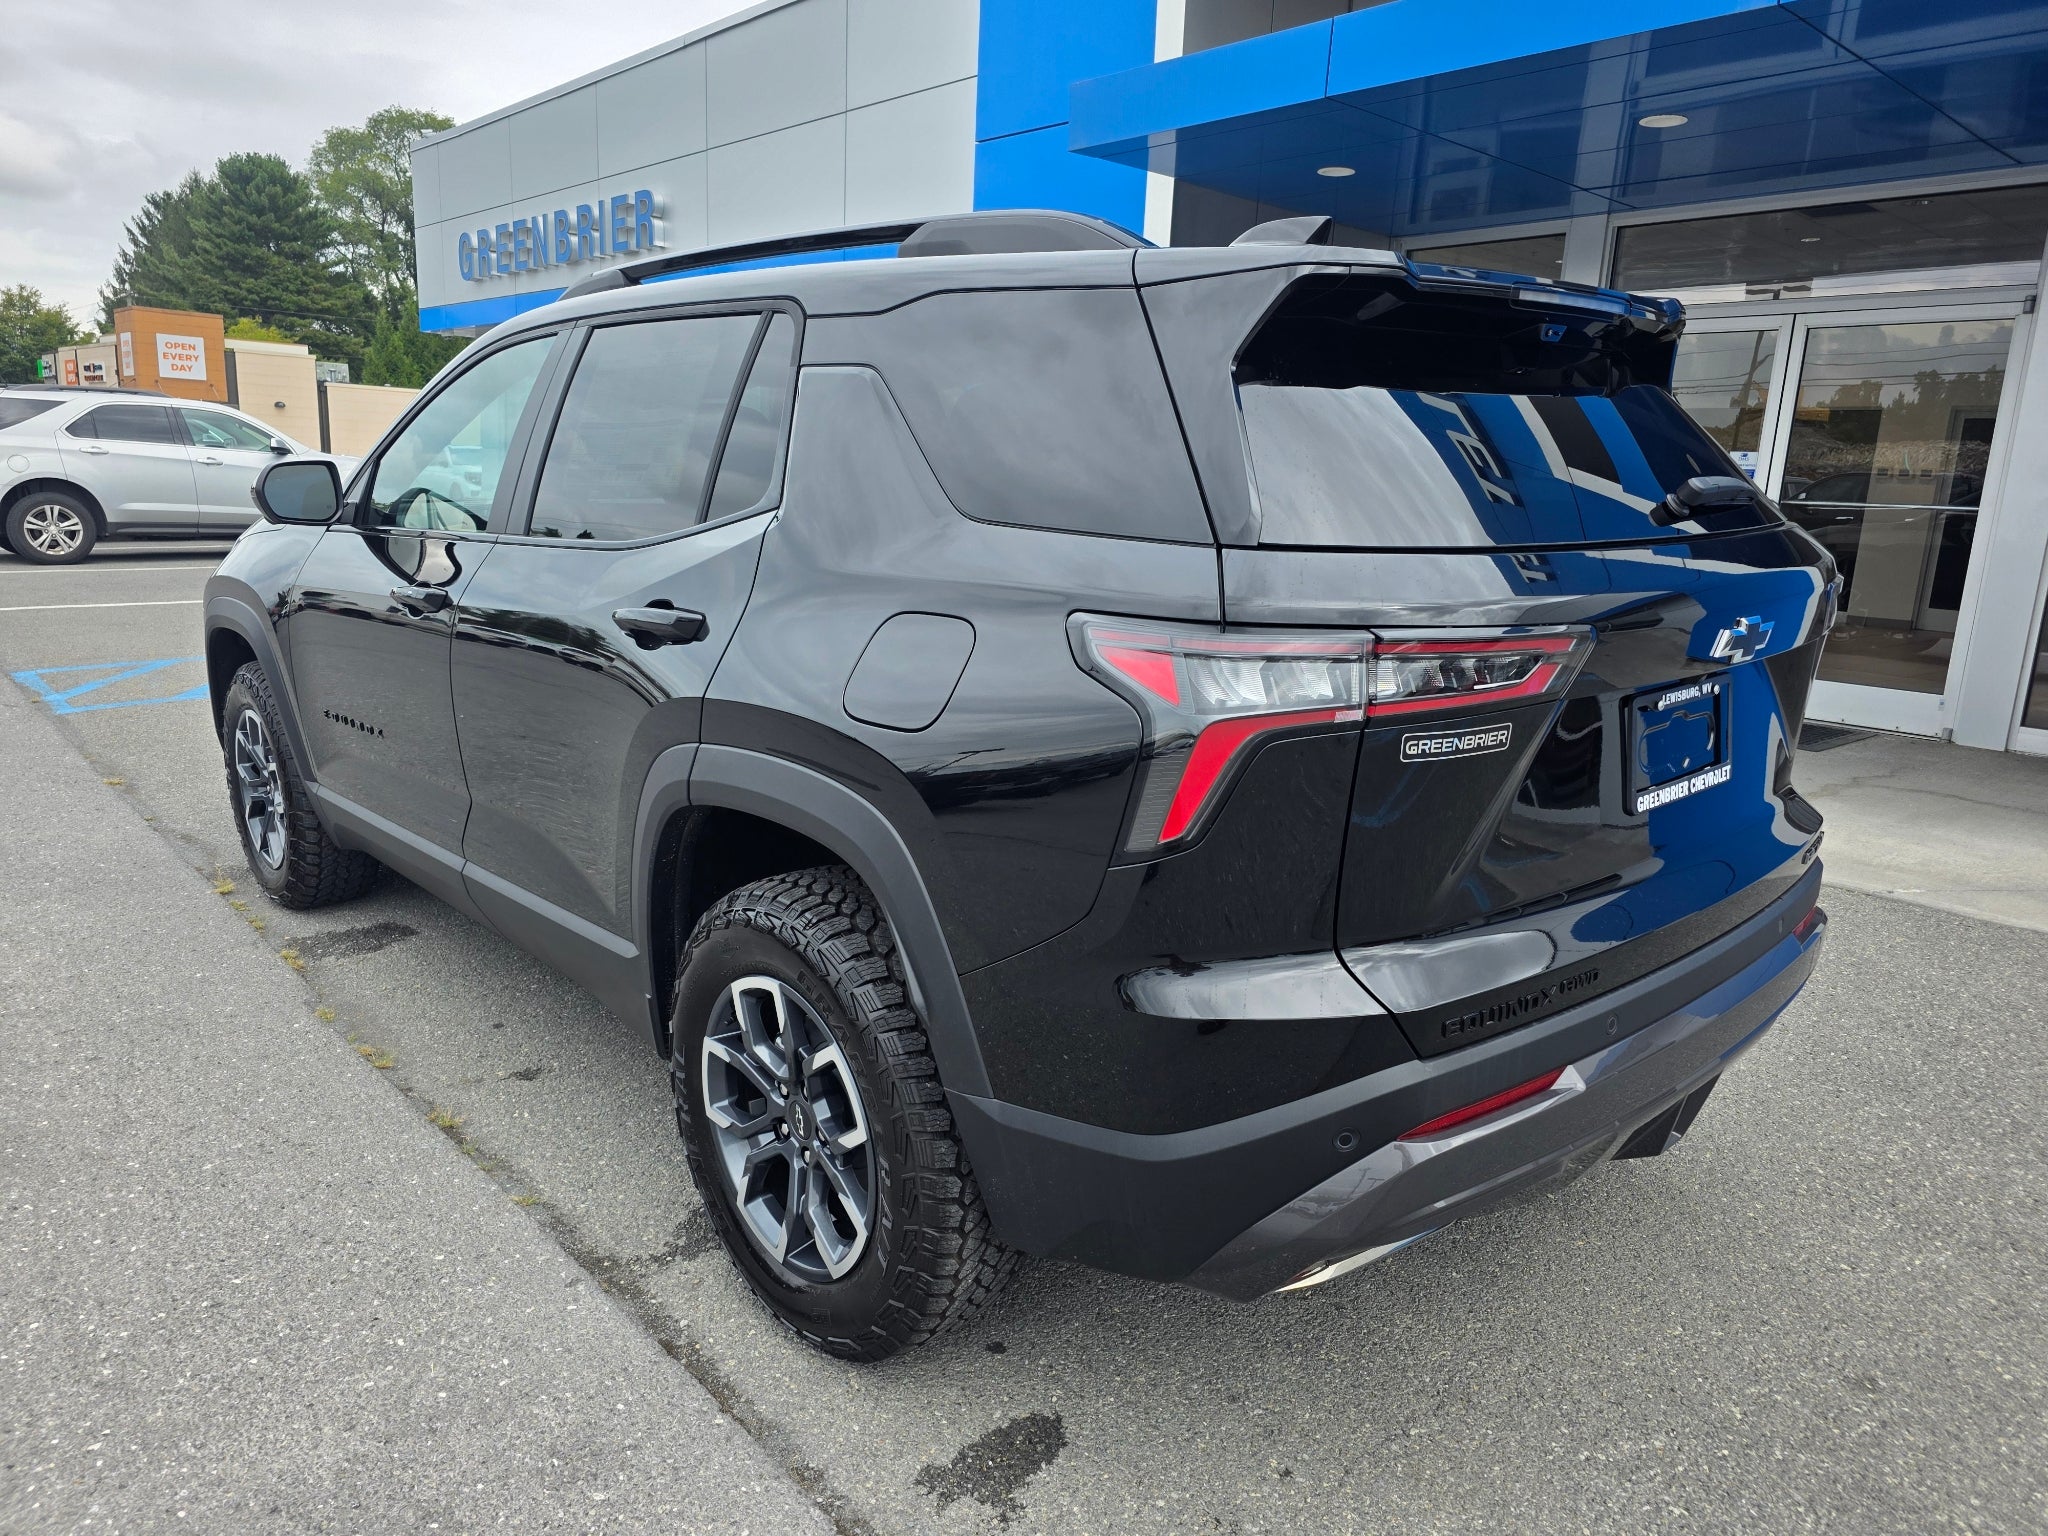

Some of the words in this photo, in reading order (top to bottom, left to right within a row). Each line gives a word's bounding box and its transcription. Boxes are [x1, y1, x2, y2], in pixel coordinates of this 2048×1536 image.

[458, 189, 659, 282] GREENBRIER
[162, 352, 200, 363] EVERY
[164, 341, 196, 352] OPEN
[170, 363, 194, 373] DAY
[1661, 686, 1701, 705] LEWISBURG,
[1701, 682, 1713, 695] WV
[1405, 730, 1508, 755] GREENBRIER
[1636, 780, 1689, 813] GREENBRIER
[1690, 764, 1731, 794] CHEVROLET
